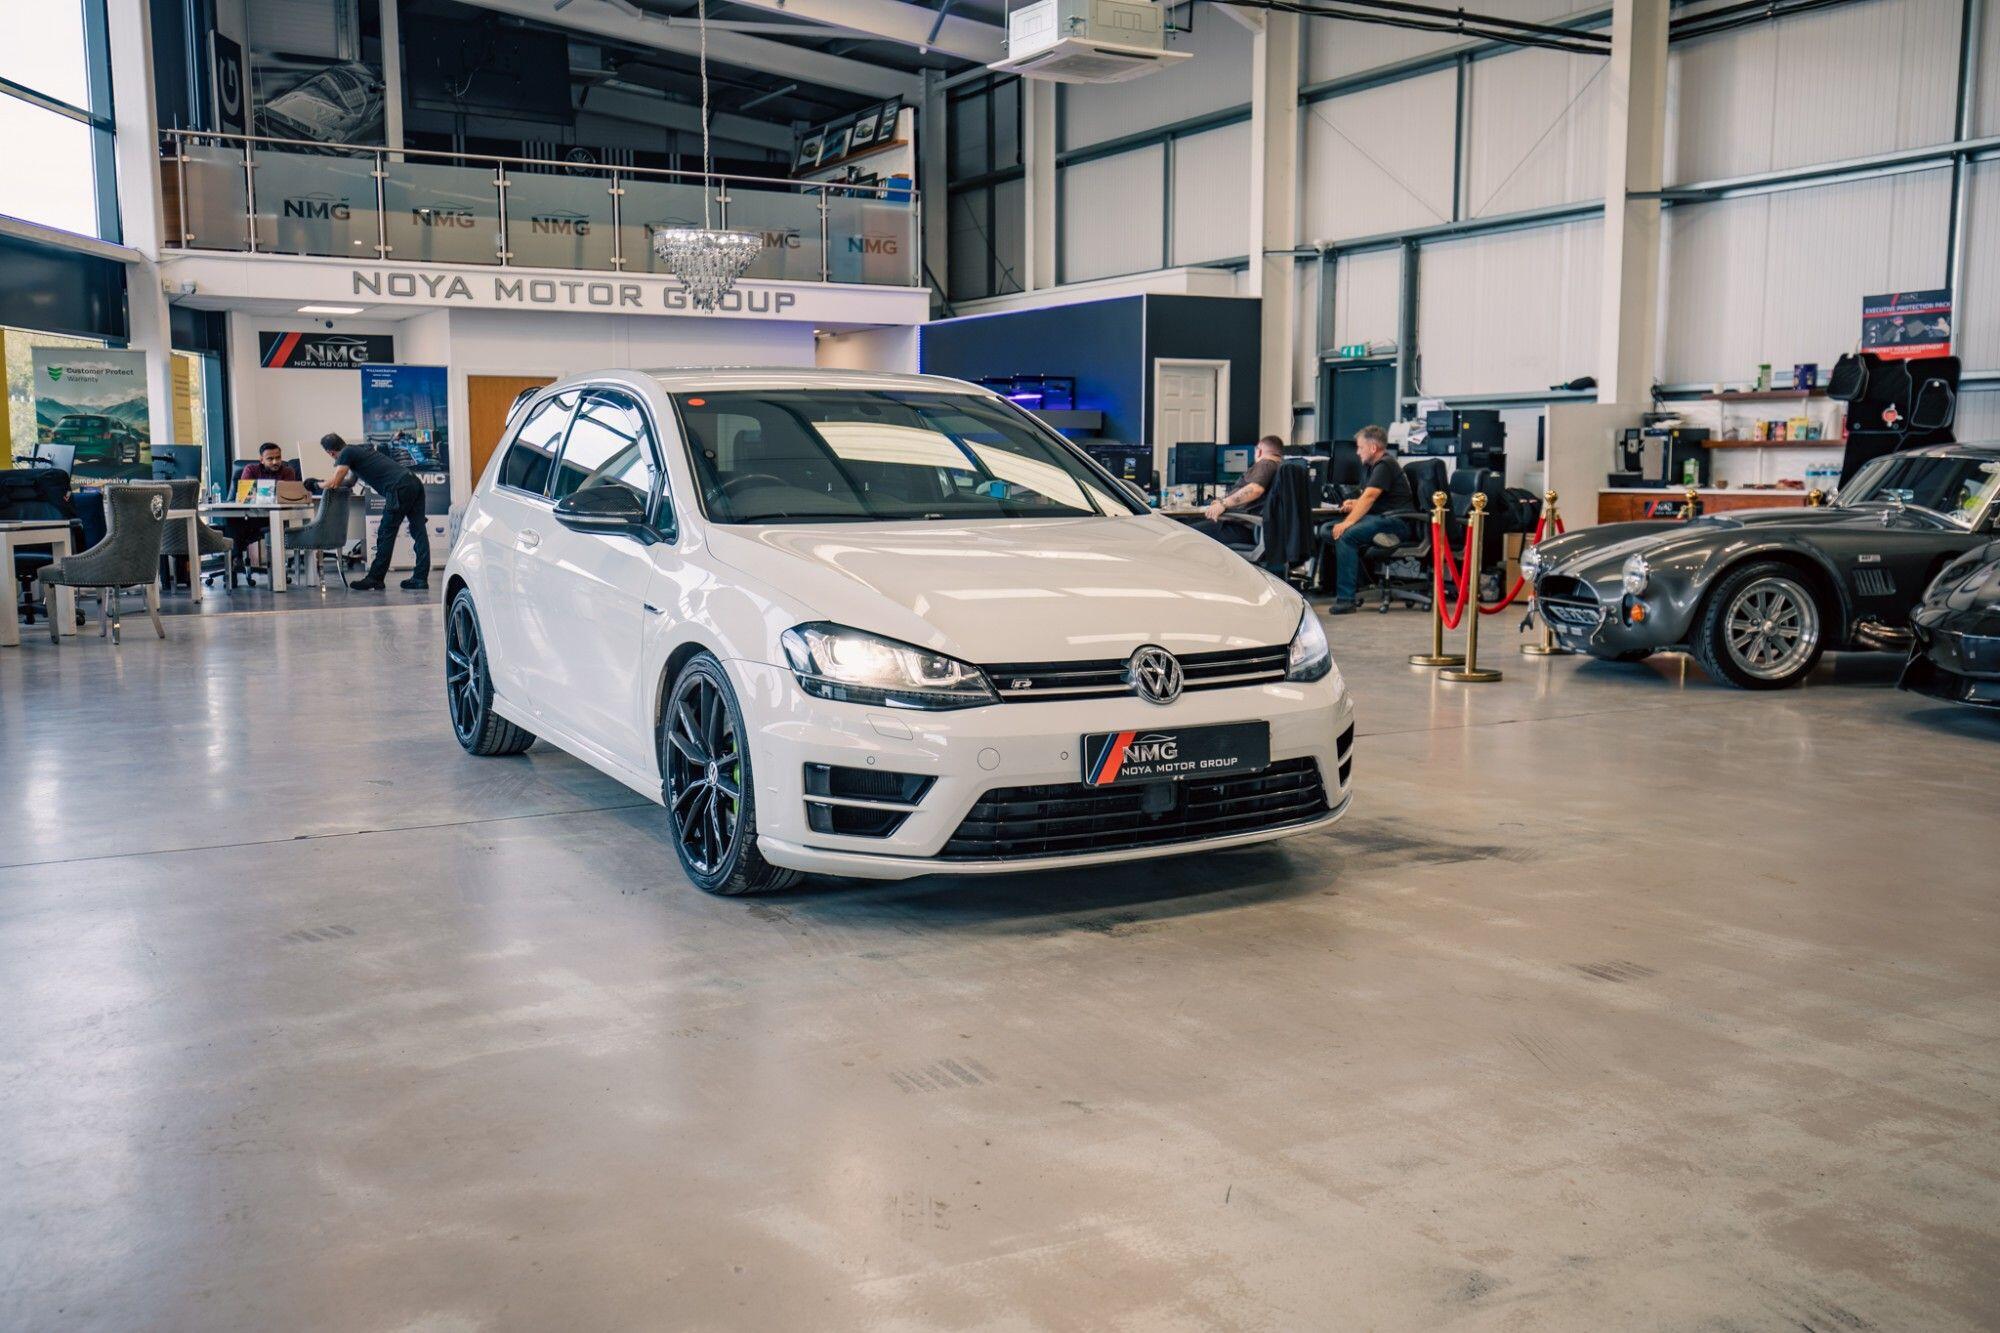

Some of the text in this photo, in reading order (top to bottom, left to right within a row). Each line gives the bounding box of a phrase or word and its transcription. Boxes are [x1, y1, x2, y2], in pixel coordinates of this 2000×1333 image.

[284, 198, 350, 220] NMG
[412, 208, 475, 229] NMG
[532, 217, 591, 236] NMG
[760, 231, 800, 249] MG
[848, 236, 898, 255] NMG
[352, 270, 796, 314] NOYA MOTOR GOUP
[304, 343, 369, 363] NMG
[66, 367, 134, 376] Customer Protect
[66, 375, 98, 384] Warranty
[1121, 741, 1179, 764] NMG
[1121, 756, 1239, 776] NOYA MOTOR GROUP
